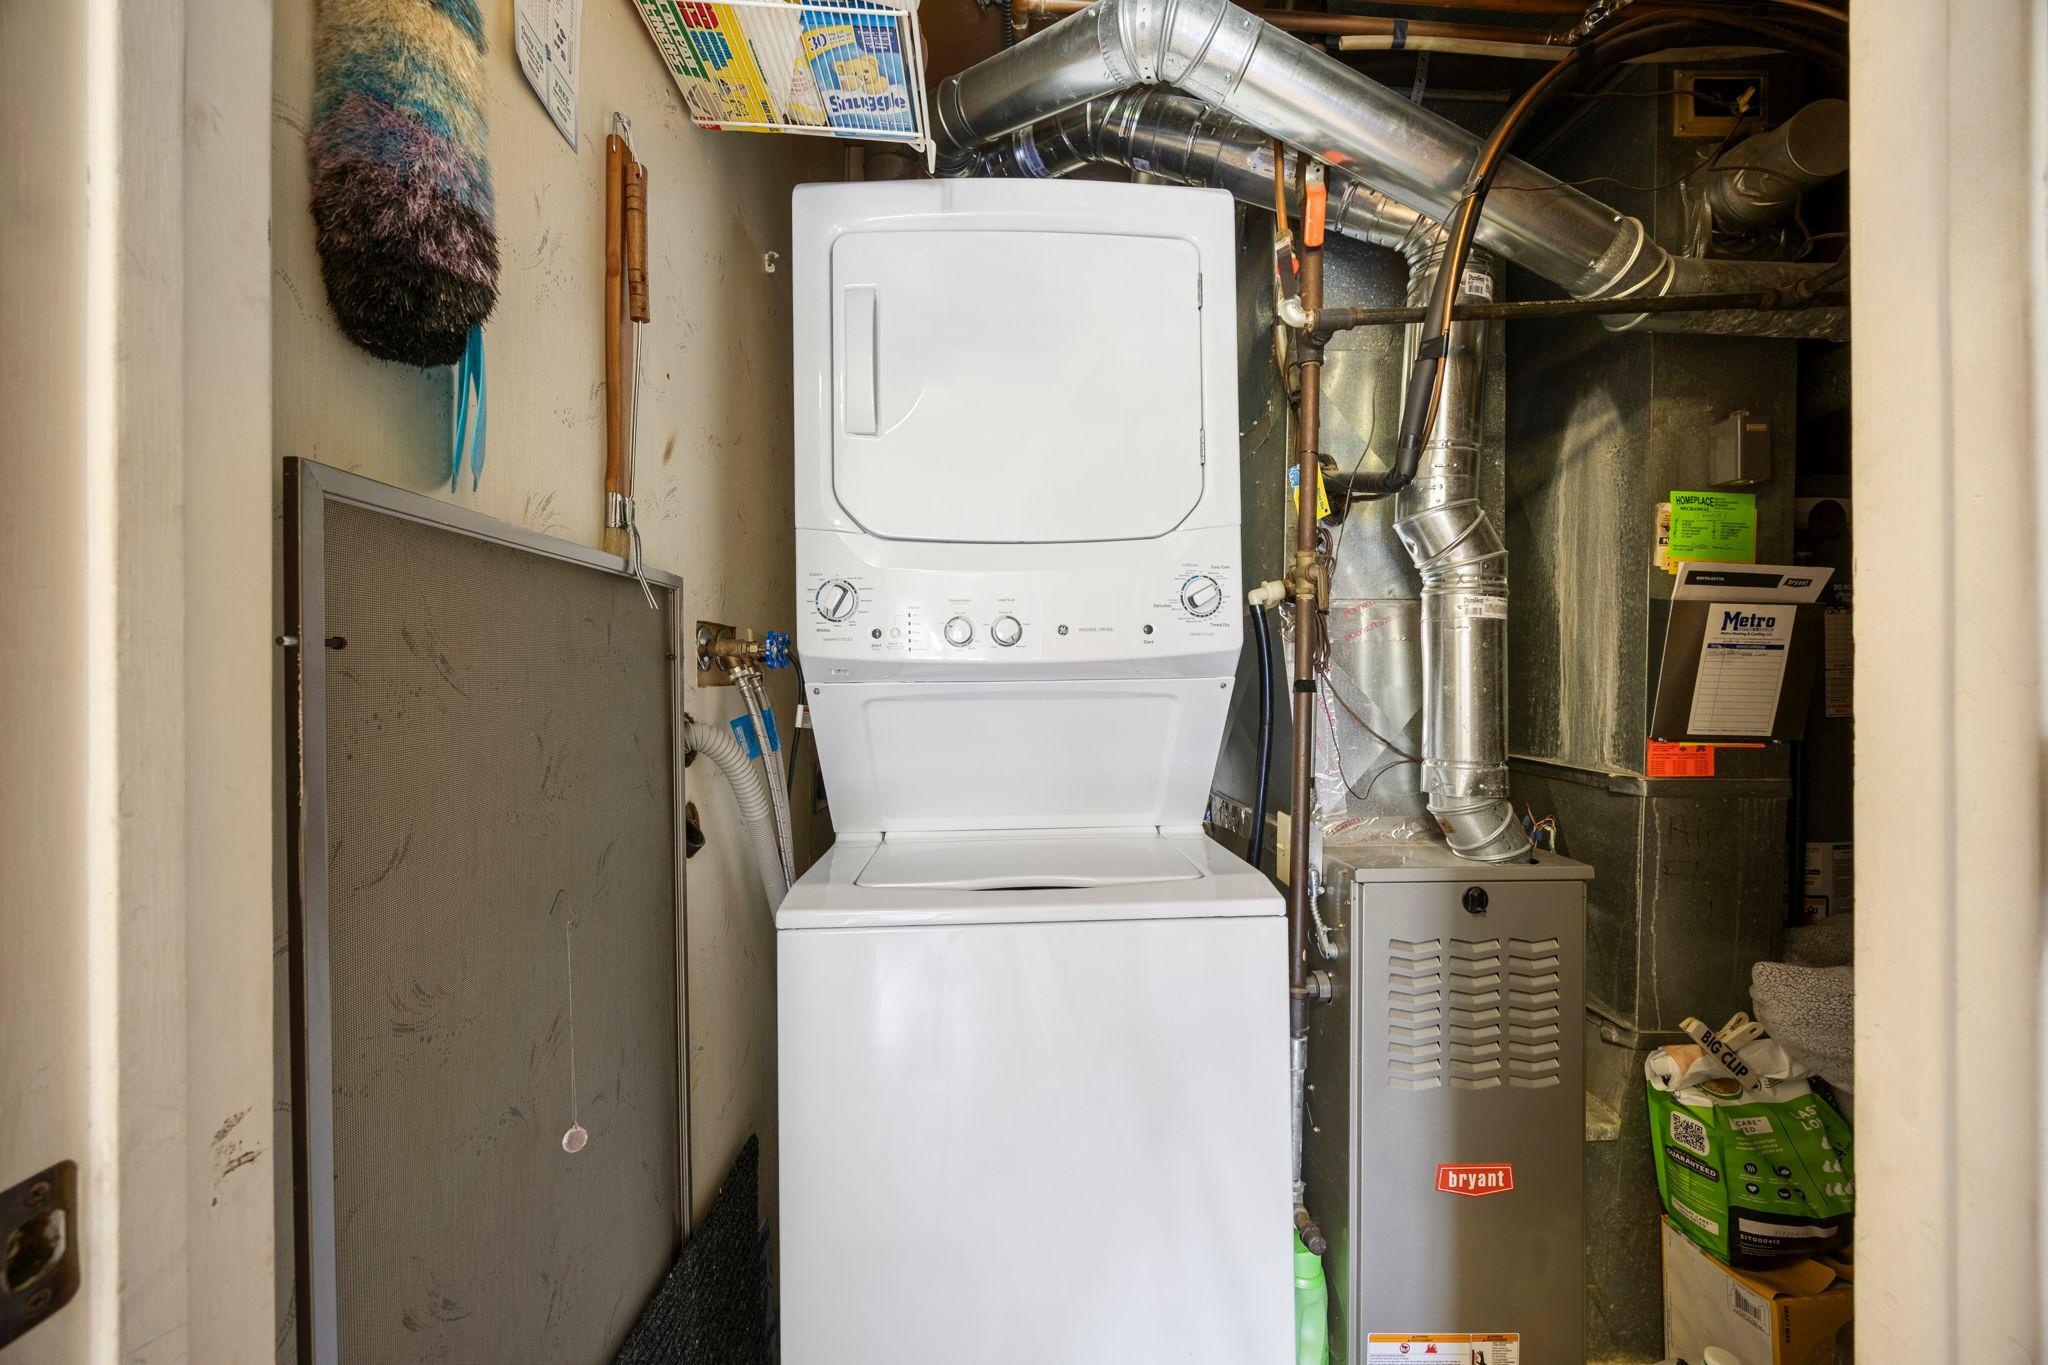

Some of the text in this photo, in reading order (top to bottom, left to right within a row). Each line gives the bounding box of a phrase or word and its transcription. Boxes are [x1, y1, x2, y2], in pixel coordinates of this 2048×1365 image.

[643, 3, 685, 67] LINERS
[808, 34, 827, 52] 30
[675, 35, 698, 69] PAN
[829, 92, 906, 112] Snuggle
[1675, 495, 1714, 507] HOMEPLACE
[1721, 611, 1776, 631] Metro
[1701, 1029, 1749, 1078] BIG CLIP
[1449, 1171, 1504, 1189] bryant
